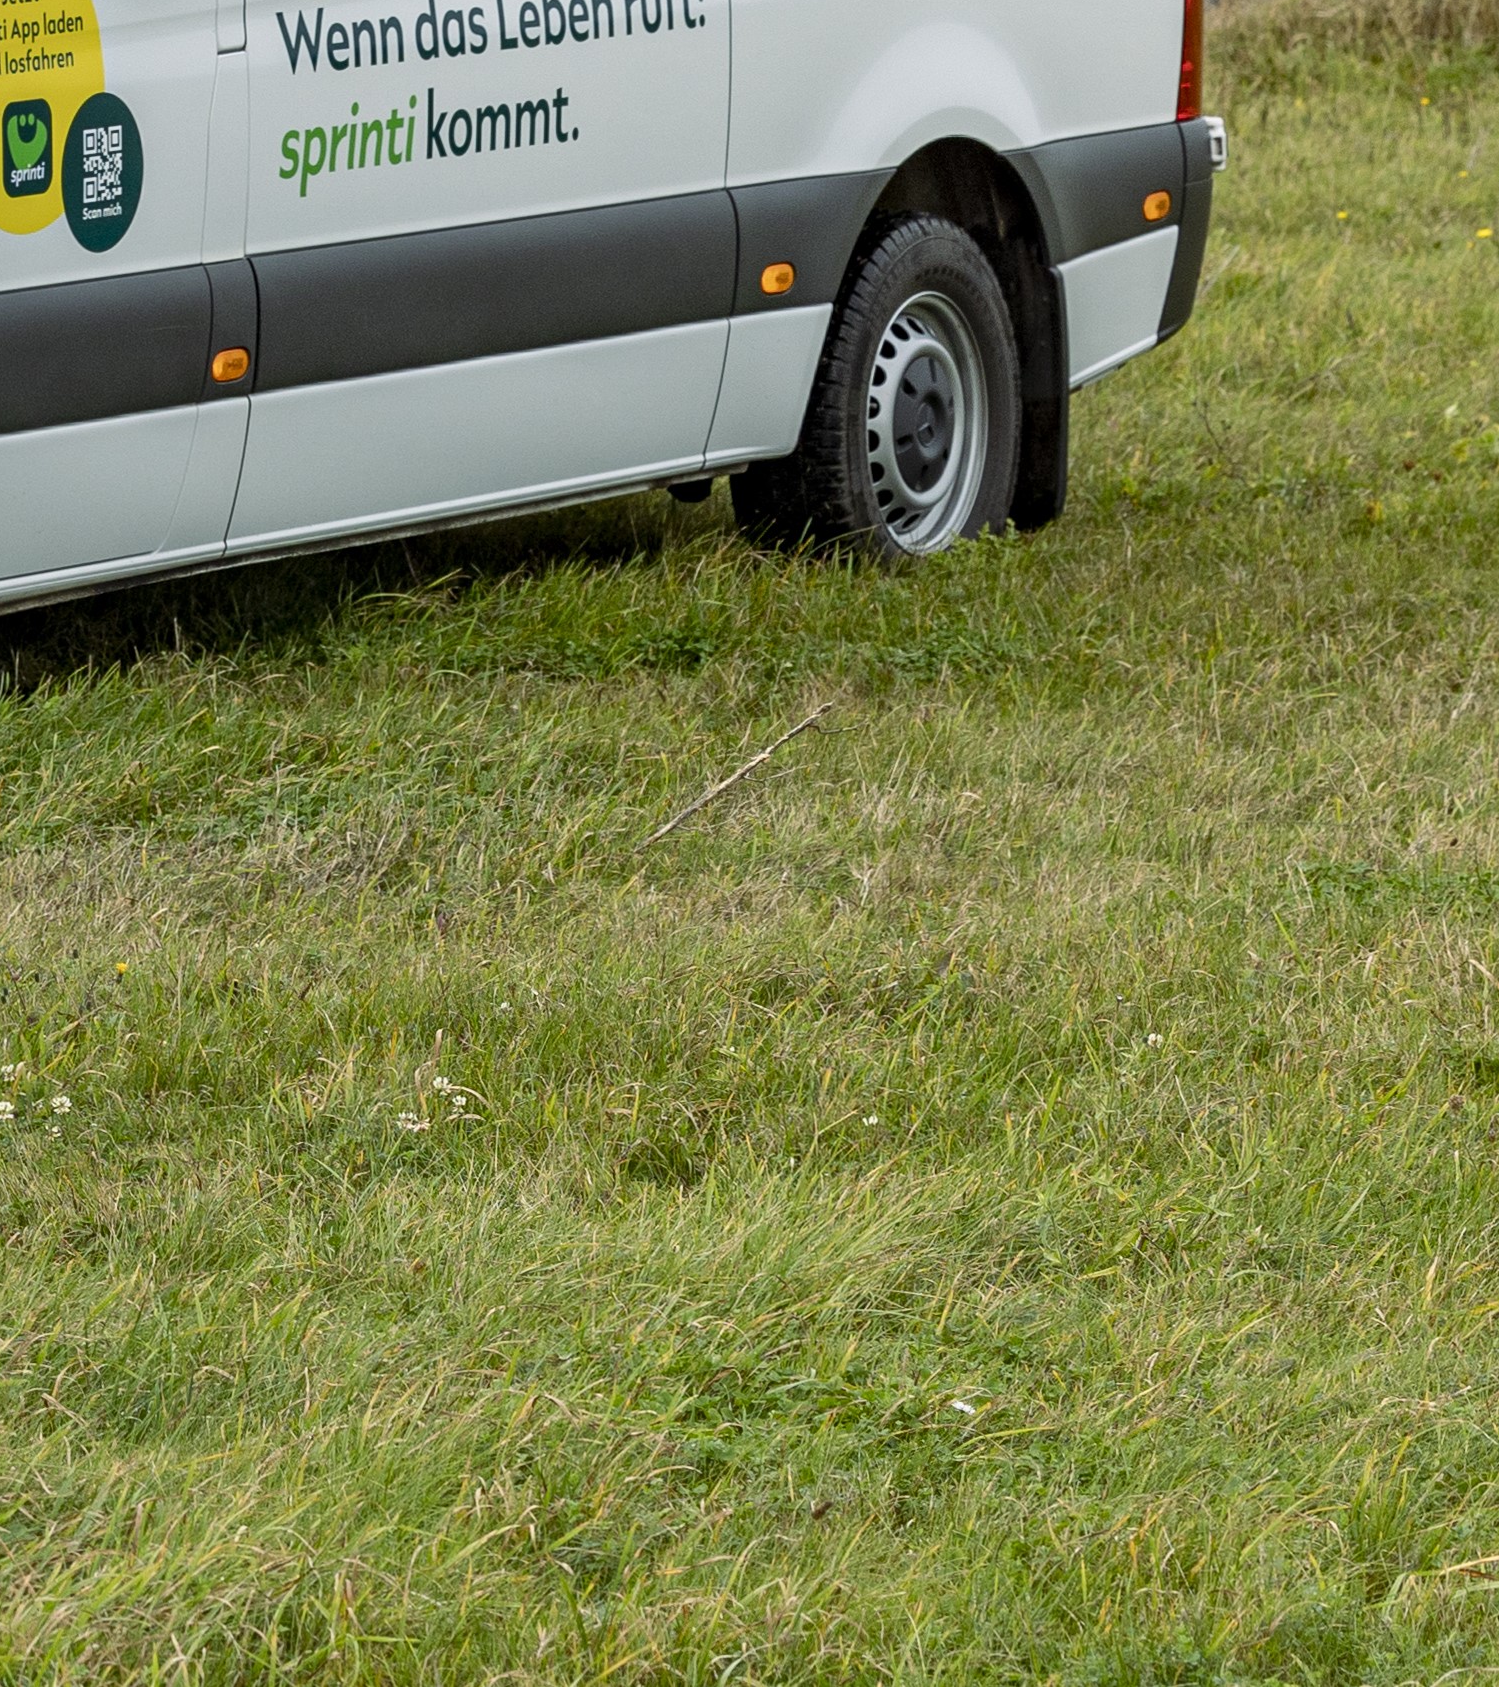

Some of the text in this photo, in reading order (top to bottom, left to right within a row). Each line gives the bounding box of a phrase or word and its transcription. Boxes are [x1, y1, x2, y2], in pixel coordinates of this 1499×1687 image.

[10, 18, 41, 45] App
[43, 9, 84, 36] laden
[276, 7, 405, 75] Wenn
[4, 46, 75, 75] losfahren
[278, 87, 580, 198] sprinti kommt.
[10, 161, 46, 188] sprinti
[82, 201, 123, 221] Scan mich
